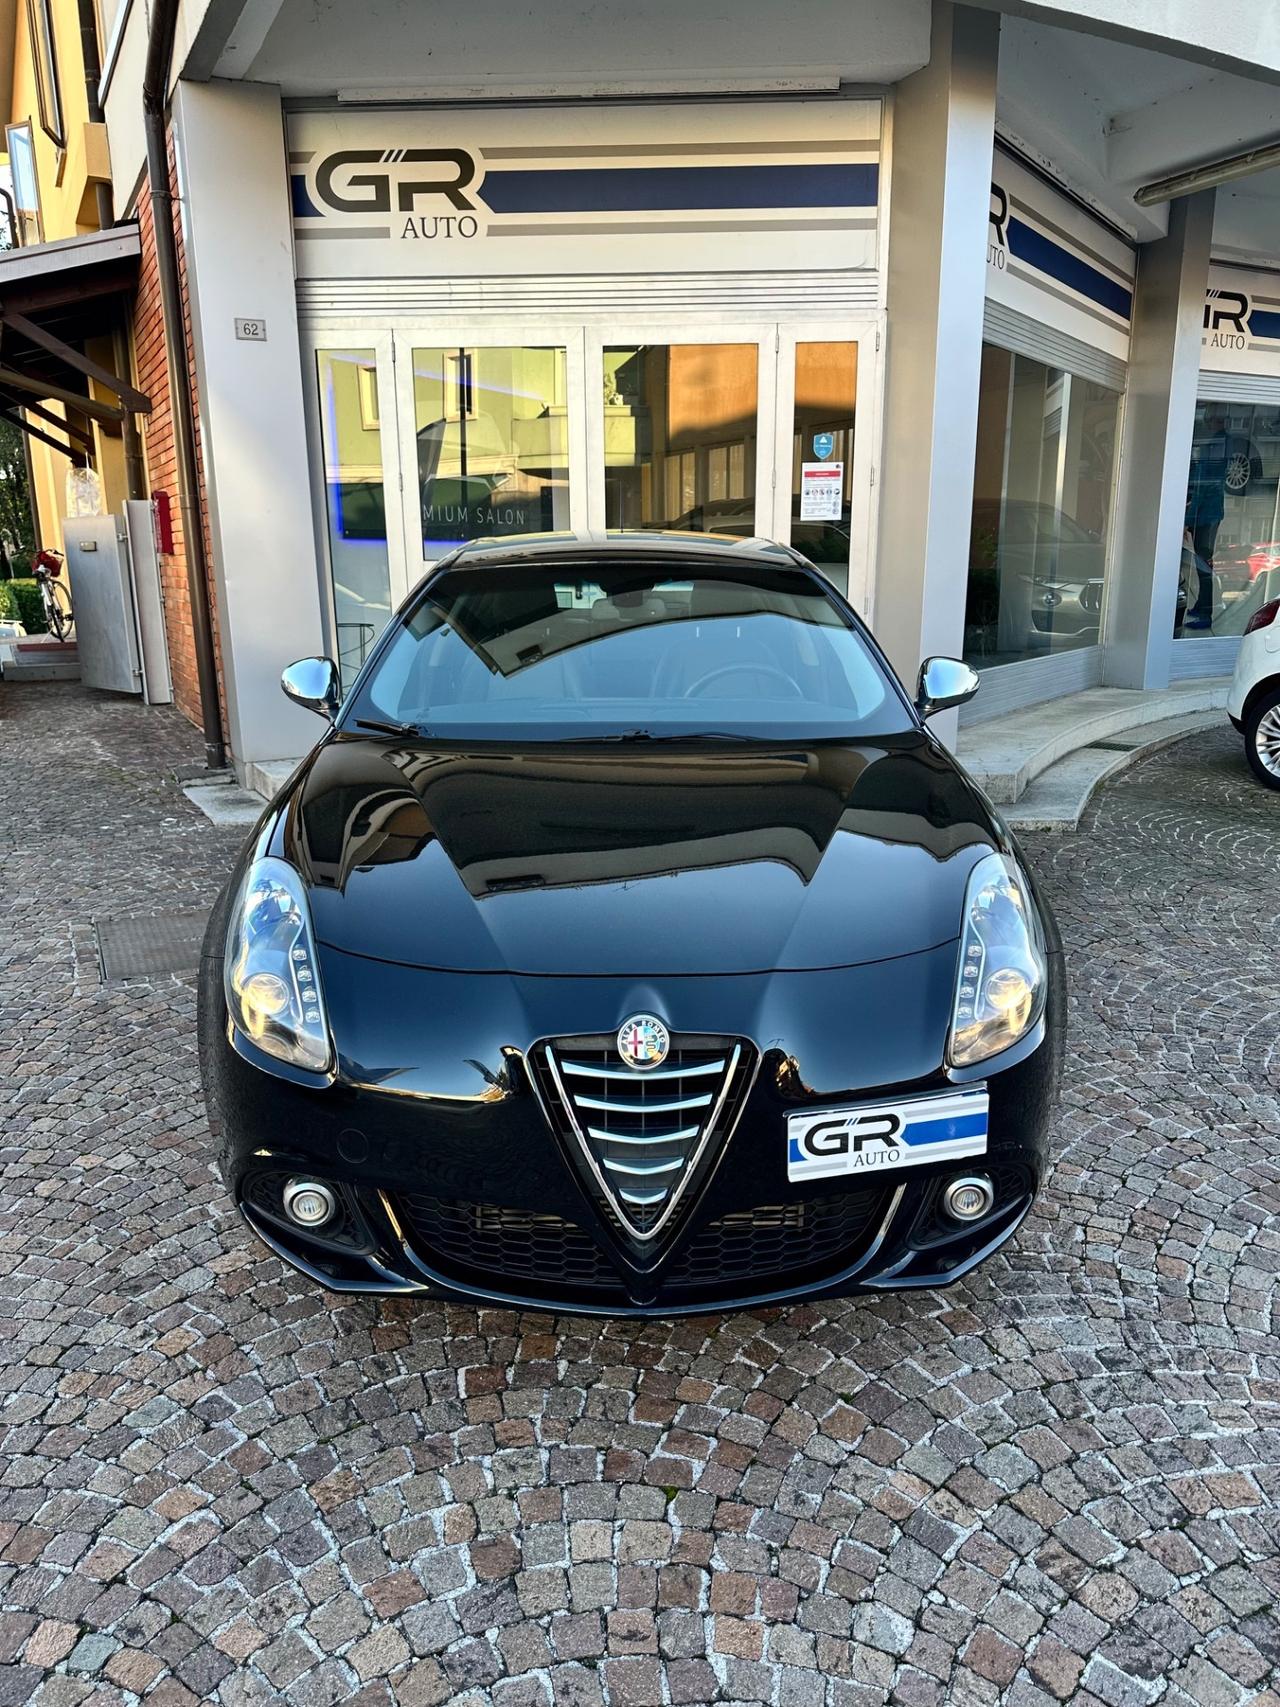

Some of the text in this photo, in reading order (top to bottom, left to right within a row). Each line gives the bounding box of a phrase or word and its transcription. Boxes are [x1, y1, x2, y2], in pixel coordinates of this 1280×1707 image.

[315, 148, 477, 212] GR
[401, 215, 478, 239] AUTO
[243, 322, 259, 336] 62
[1210, 333, 1245, 351] AUTO
[423, 504, 525, 525] MIUM SALON
[804, 1113, 901, 1157] GR
[854, 1149, 901, 1168] AUTO
